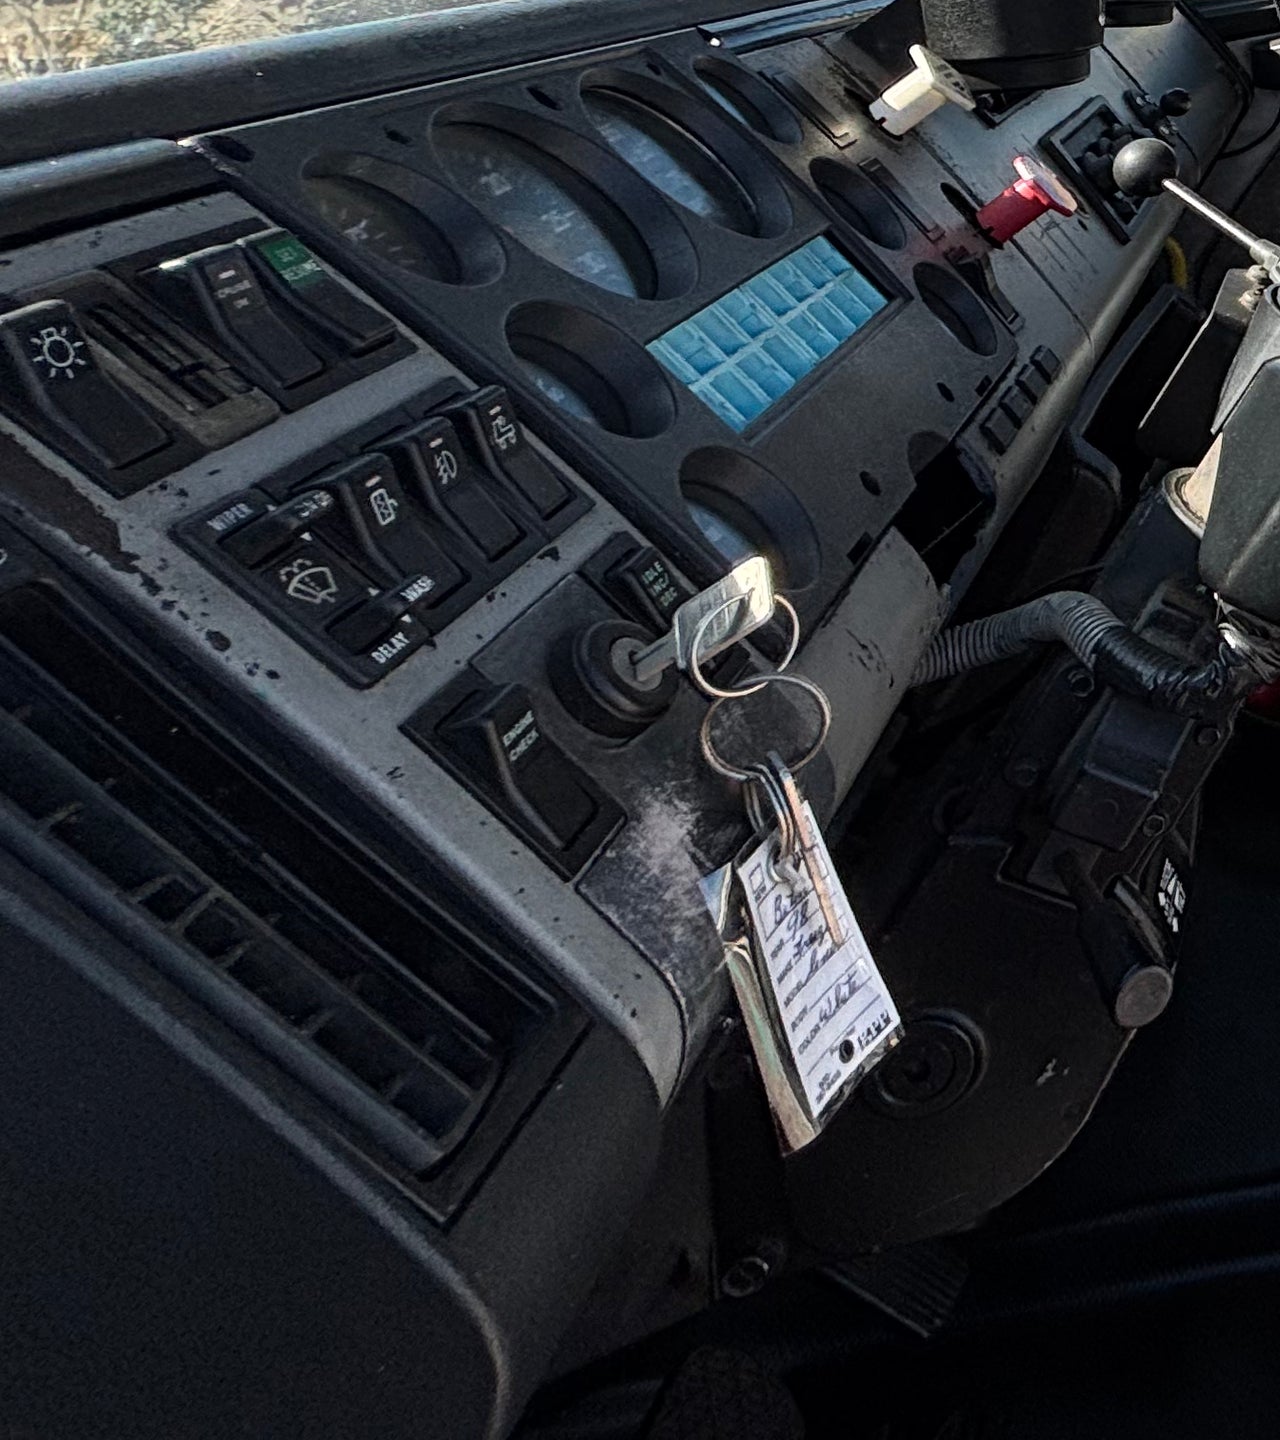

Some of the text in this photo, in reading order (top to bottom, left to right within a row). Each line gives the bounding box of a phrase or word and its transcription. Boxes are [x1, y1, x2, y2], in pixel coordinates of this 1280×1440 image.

[206, 503, 254, 531] WIPER
[642, 561, 664, 584] IDLE
[400, 575, 436, 602] WASH
[660, 587, 678, 607] DEC
[371, 631, 410, 664] DELAY
[503, 710, 535, 747] ENGINE
[510, 727, 539, 761] CHECK
